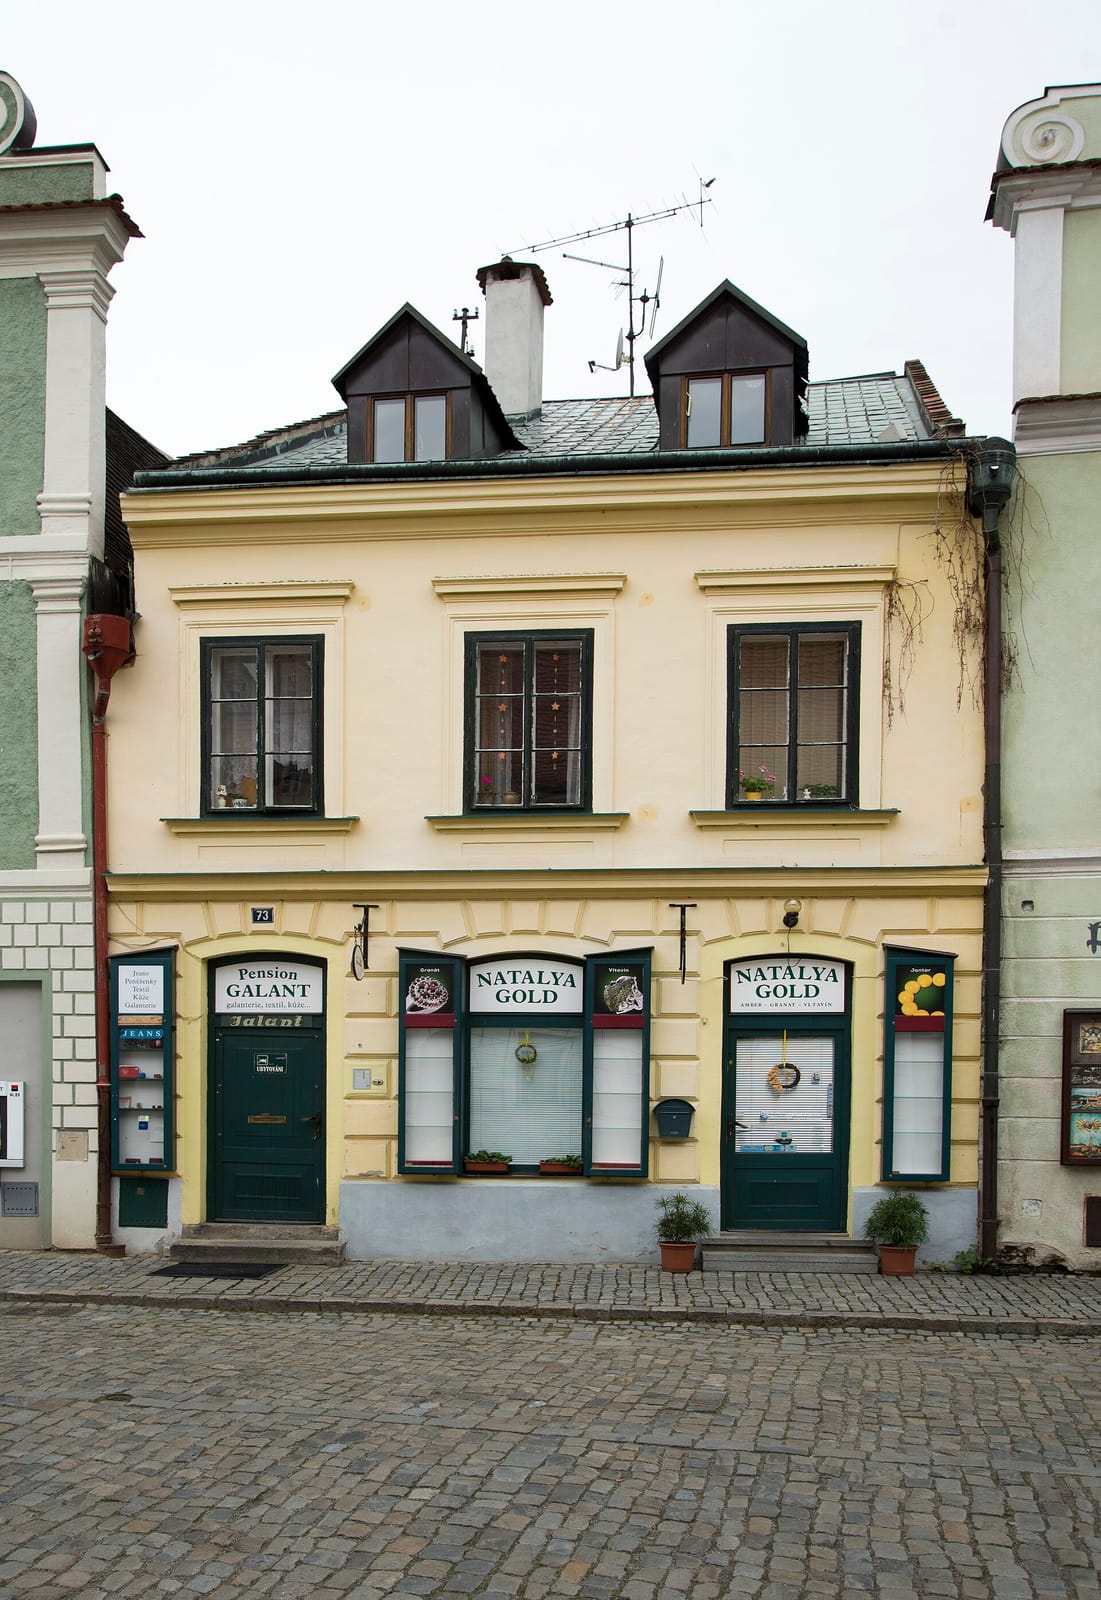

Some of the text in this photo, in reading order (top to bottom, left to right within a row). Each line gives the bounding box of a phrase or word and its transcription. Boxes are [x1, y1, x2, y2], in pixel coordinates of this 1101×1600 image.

[256, 910, 269, 921] 73
[238, 966, 298, 981] Pension
[476, 970, 577, 988] NATALYA
[736, 965, 839, 984] NATALYA
[226, 984, 311, 998] GALANT
[495, 989, 559, 1004] GOLD
[755, 984, 820, 999] GOLD
[265, 1001, 286, 1009] textil,
[229, 1015, 304, 1027] Galant
